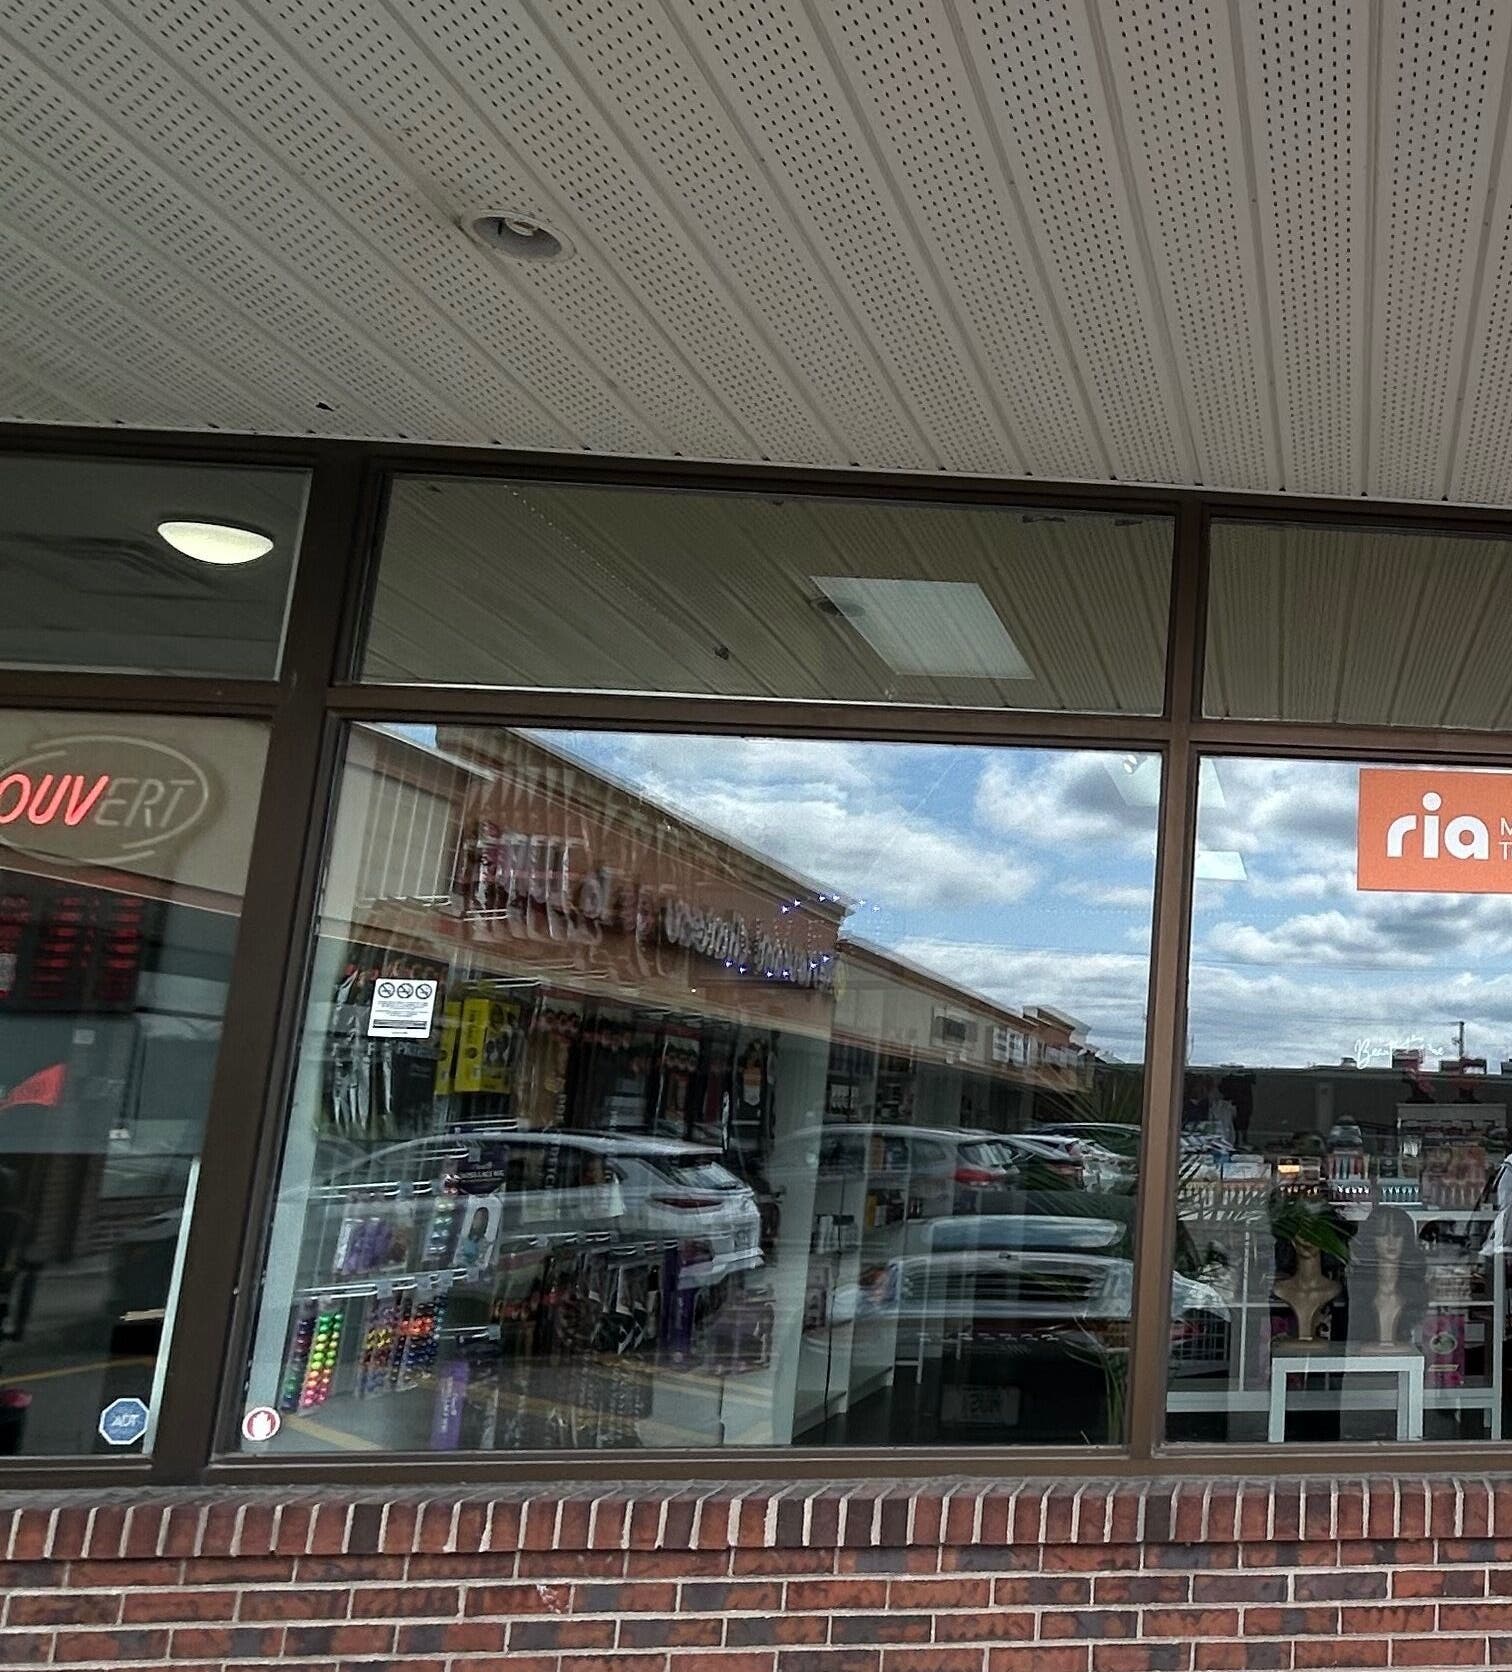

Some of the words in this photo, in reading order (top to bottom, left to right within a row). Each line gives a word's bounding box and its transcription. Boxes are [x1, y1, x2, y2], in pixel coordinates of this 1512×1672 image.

[0, 774, 196, 828] OUVERT
[1386, 791, 1491, 860] ria
[111, 1414, 139, 1428] ADT
